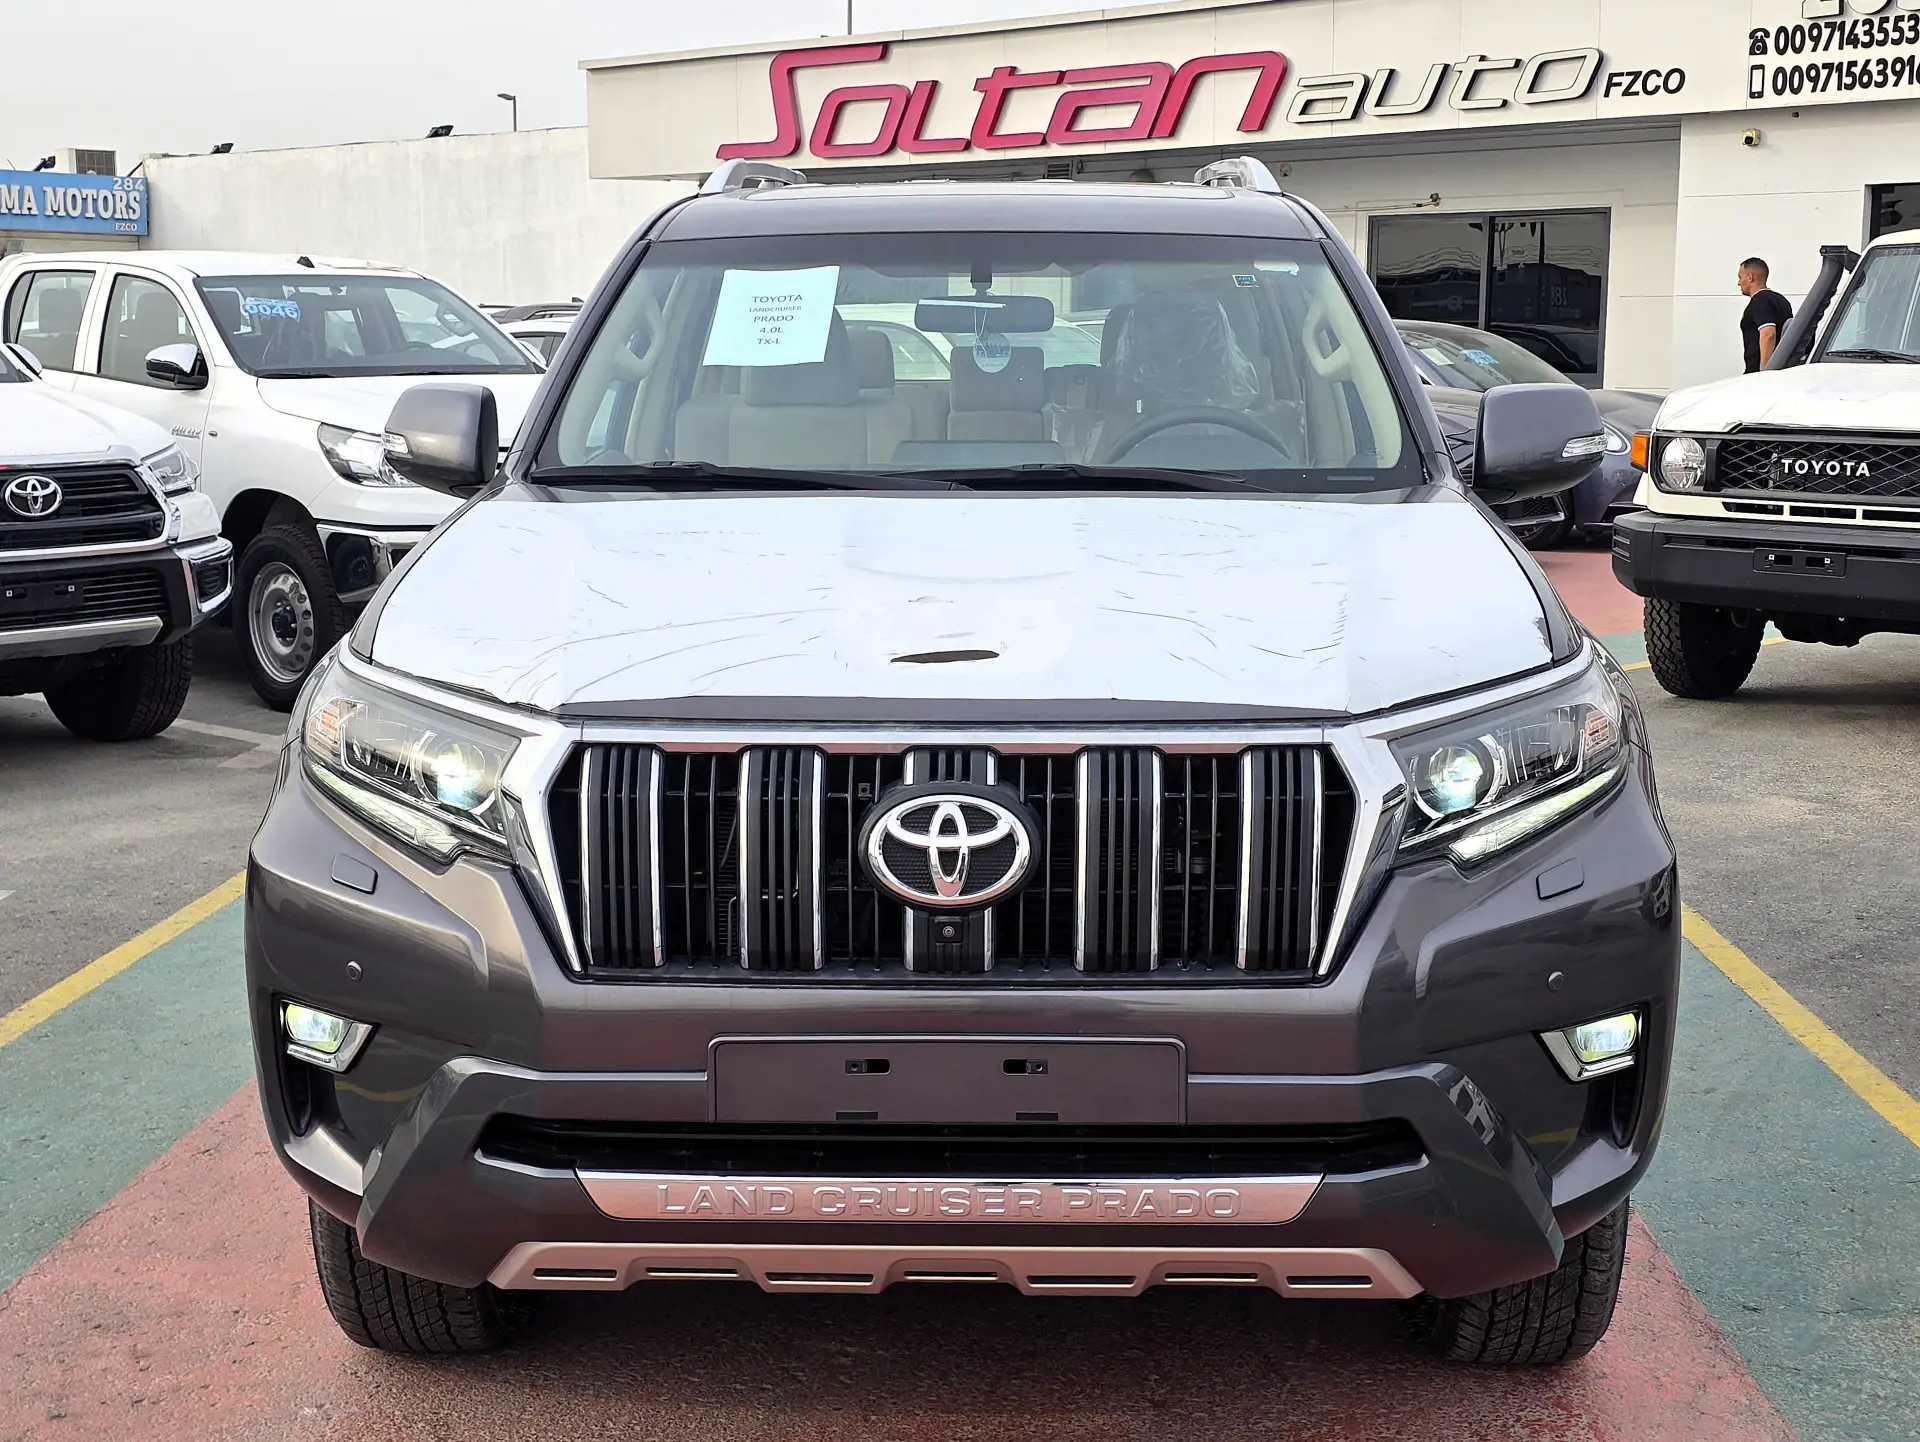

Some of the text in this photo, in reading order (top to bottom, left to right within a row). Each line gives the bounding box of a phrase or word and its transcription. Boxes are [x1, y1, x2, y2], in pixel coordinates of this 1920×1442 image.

[1774, 14, 1920, 56] 0097143553
[1286, 46, 1605, 124] auto
[1604, 67, 1687, 100] FZCO
[112, 177, 145, 192] 284
[43, 186, 141, 220] MOTORS
[752, 294, 803, 303] TOYOTA
[245, 304, 298, 319] 0046
[749, 305, 802, 313] LANDCRUISER
[753, 314, 794, 323] PRADO
[759, 326, 783, 334] 4.0L
[757, 337, 781, 345] TX-L
[1781, 458, 1871, 477] TOYOTA
[656, 1184, 1243, 1219] LAND CRUISER PRADO
